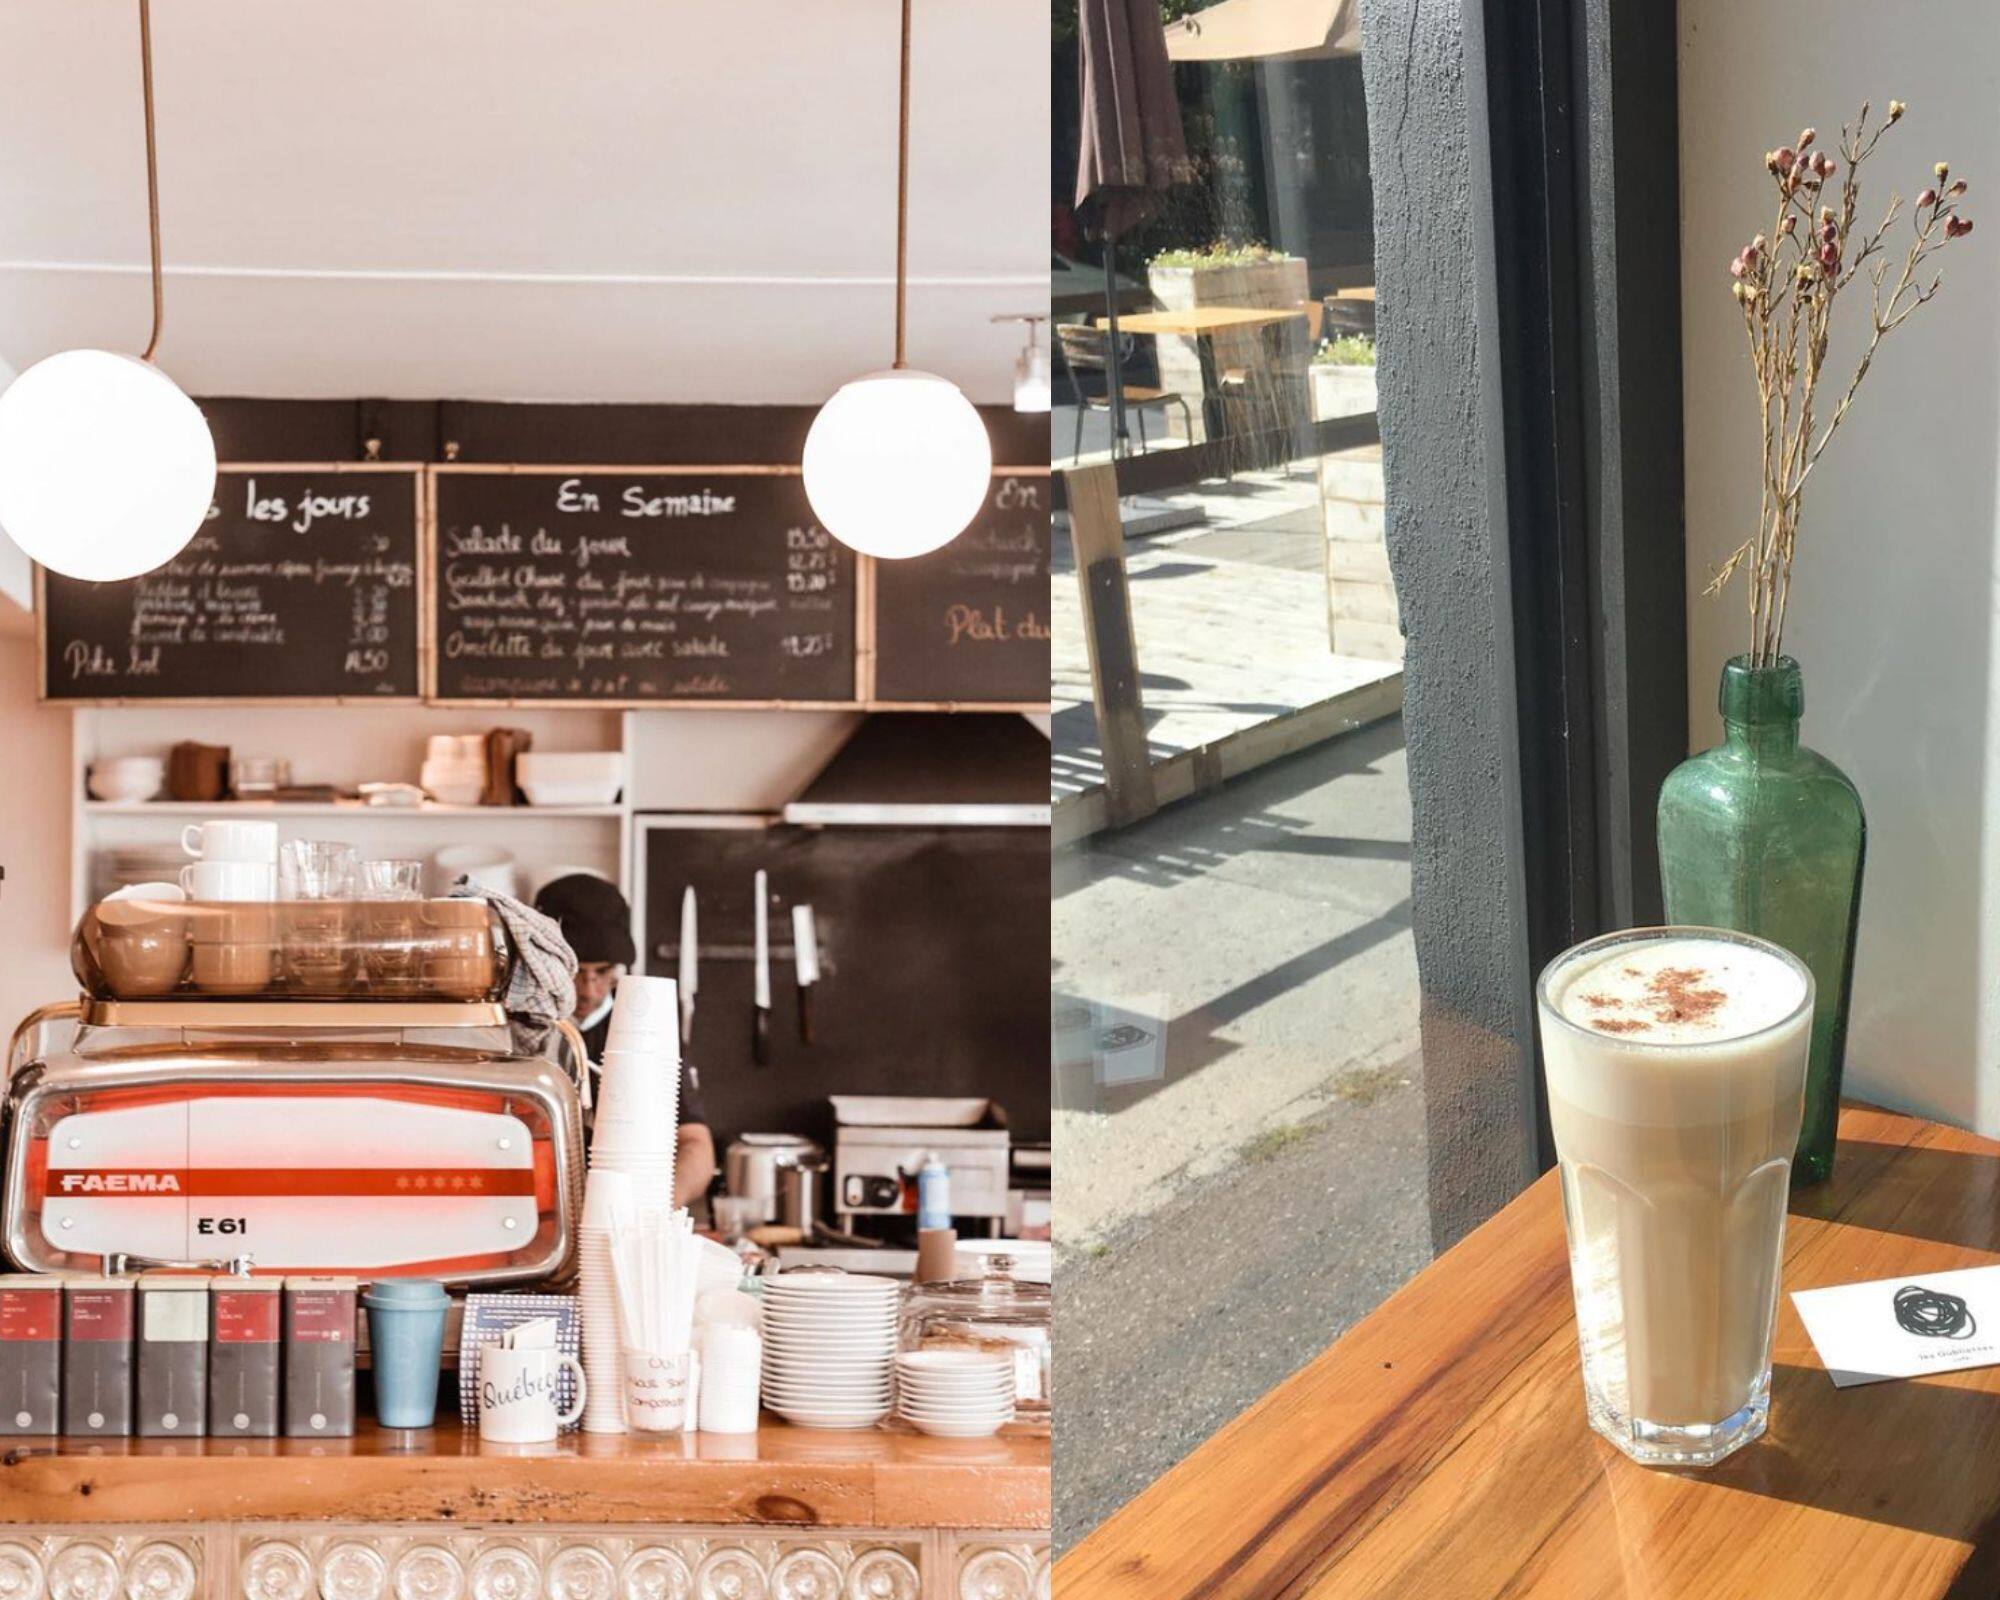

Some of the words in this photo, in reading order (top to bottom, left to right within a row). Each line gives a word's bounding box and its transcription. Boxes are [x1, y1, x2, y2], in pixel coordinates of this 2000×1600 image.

[247, 478, 289, 521] les
[292, 488, 371, 534] jours
[556, 479, 600, 512] En
[621, 486, 737, 518] Semaine
[996, 478, 1041, 510] En
[447, 525, 522, 557] Salade
[530, 527, 563, 555] du
[945, 603, 1012, 645] Plat
[61, 1174, 181, 1192] FAEMA
[198, 1218, 215, 1235] E
[218, 1218, 247, 1235] 61
